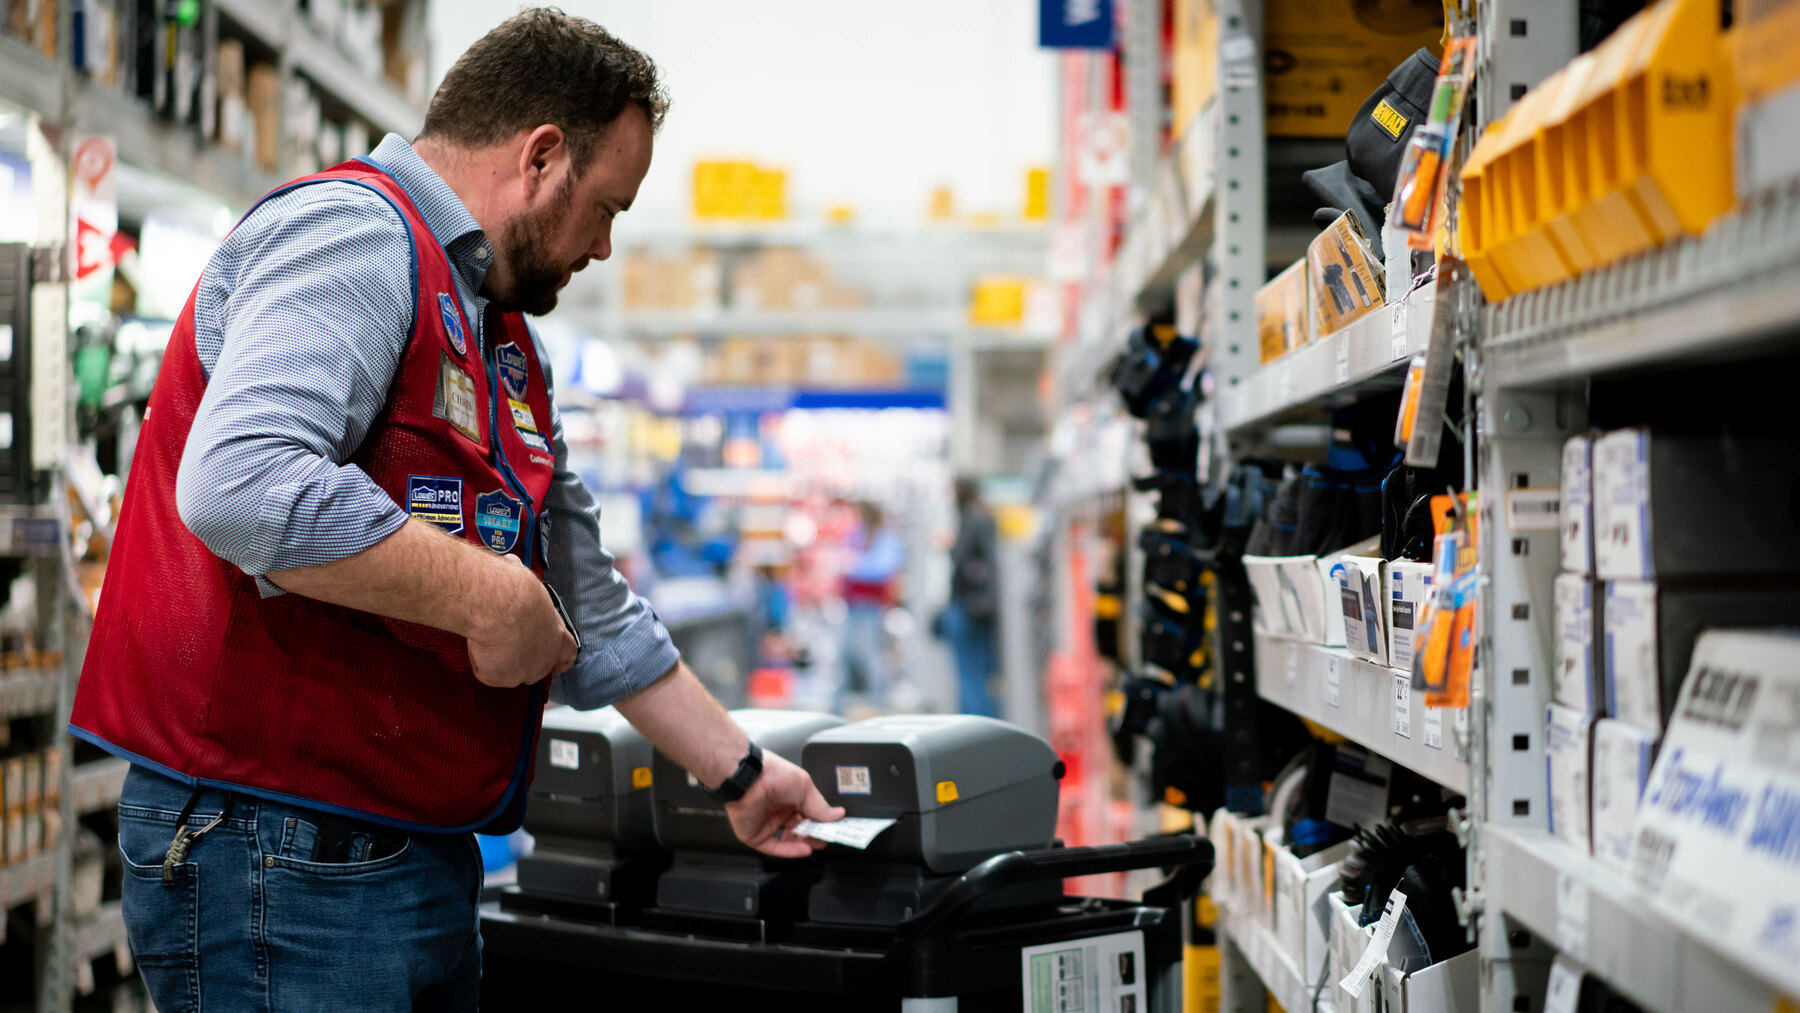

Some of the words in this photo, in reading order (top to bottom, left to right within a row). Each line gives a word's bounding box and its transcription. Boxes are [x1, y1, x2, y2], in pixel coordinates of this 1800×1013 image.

[451, 392, 473, 412] CHRIS
[438, 490, 458, 503] PRO
[483, 515, 512, 529] SMART
[491, 535, 505, 545] PRO
